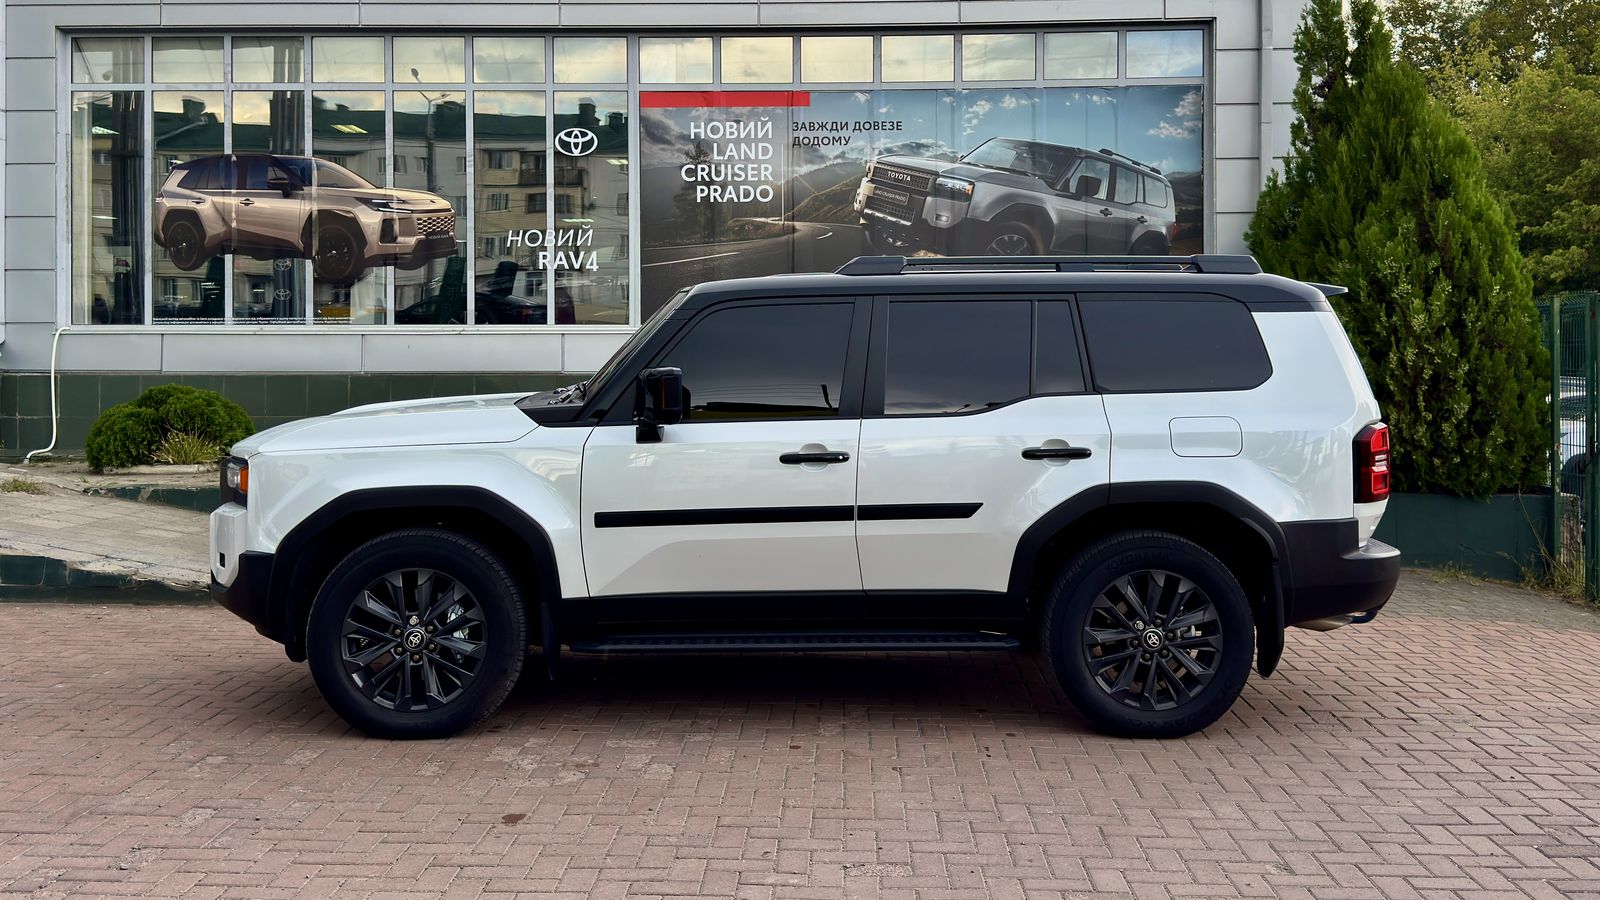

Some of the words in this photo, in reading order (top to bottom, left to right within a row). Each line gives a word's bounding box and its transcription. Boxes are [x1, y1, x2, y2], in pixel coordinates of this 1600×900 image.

[690, 117, 773, 139] НОВИЙ
[792, 121, 849, 133] ЗАВЖДИ
[852, 120, 903, 132] ДОВЕЗЕ
[792, 136, 851, 149] ДОДОМУ
[713, 143, 773, 160] LAND
[681, 164, 773, 182] CRUISER
[888, 171, 911, 182] TOYOTA
[696, 186, 773, 203] PRADO
[507, 225, 594, 247] НОВИЙ
[538, 251, 599, 272] RAV4
